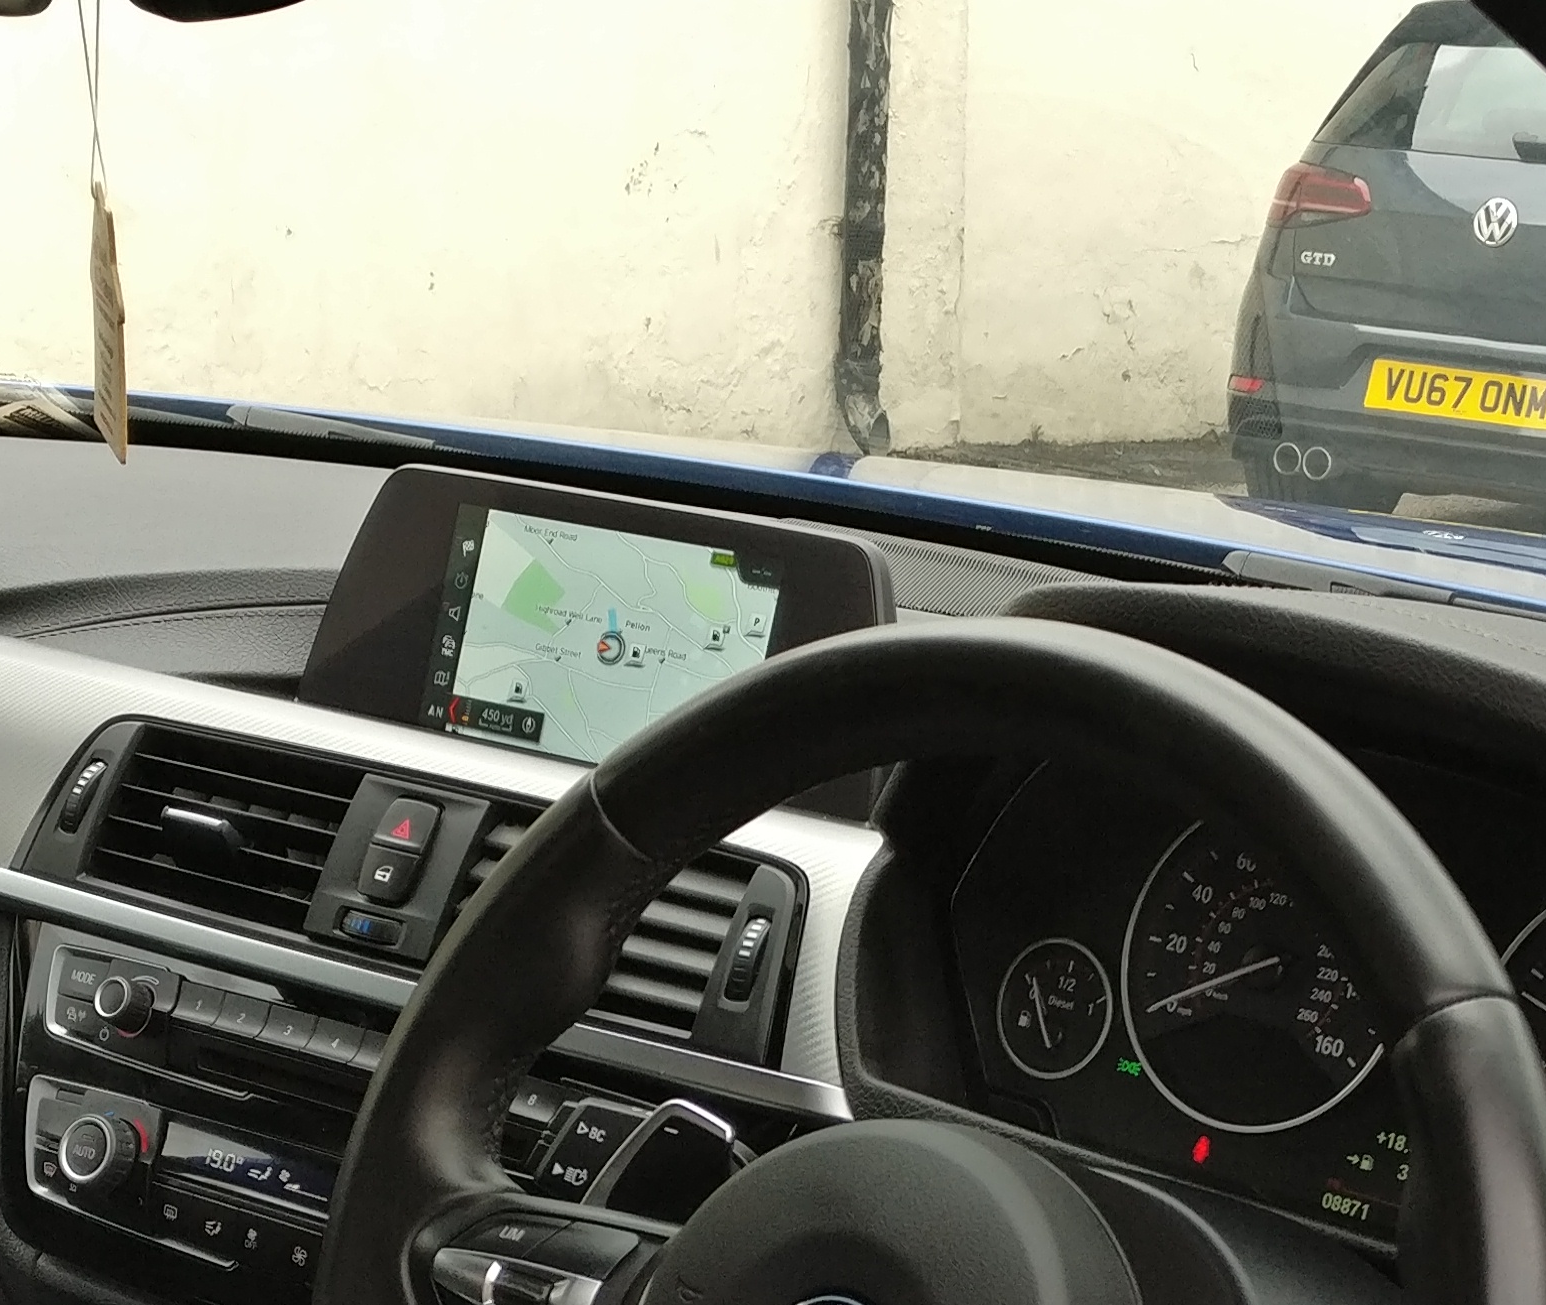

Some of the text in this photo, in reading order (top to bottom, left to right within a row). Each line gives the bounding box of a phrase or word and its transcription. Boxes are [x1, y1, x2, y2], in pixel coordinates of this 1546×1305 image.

[1300, 251, 1336, 267] GTD
[1386, 367, 1473, 409] VU67
[524, 525, 578, 542] Moor End Road
[585, 613, 603, 624] Lane
[625, 619, 651, 632] Pellon
[560, 647, 582, 660] Street
[644, 645, 687, 661] ueens Road
[481, 707, 514, 726] 450 yd
[1191, 884, 1213, 904] 40
[1269, 892, 1288, 906] 120
[1249, 897, 1267, 911] 100
[1165, 933, 1188, 954] 20
[1207, 941, 1222, 953] 40
[1203, 961, 1216, 975] 20
[1316, 967, 1339, 982] 220
[70, 969, 96, 985] MODE
[1058, 976, 1077, 992] 1/2
[1047, 995, 1074, 1011] Diesel
[1310, 987, 1332, 1003] 240
[195, 999, 202, 1011] 1
[1087, 1003, 1094, 1016] 1
[236, 1013, 246, 1024] 2
[1296, 1008, 1319, 1023] 260
[283, 1025, 293, 1036] 3
[1315, 1035, 1345, 1057] 160
[527, 1094, 538, 1106] 8
[73, 1144, 96, 1160] AUTO
[1321, 1192, 1370, 1220] 08871
[499, 1225, 526, 1242] LIM
